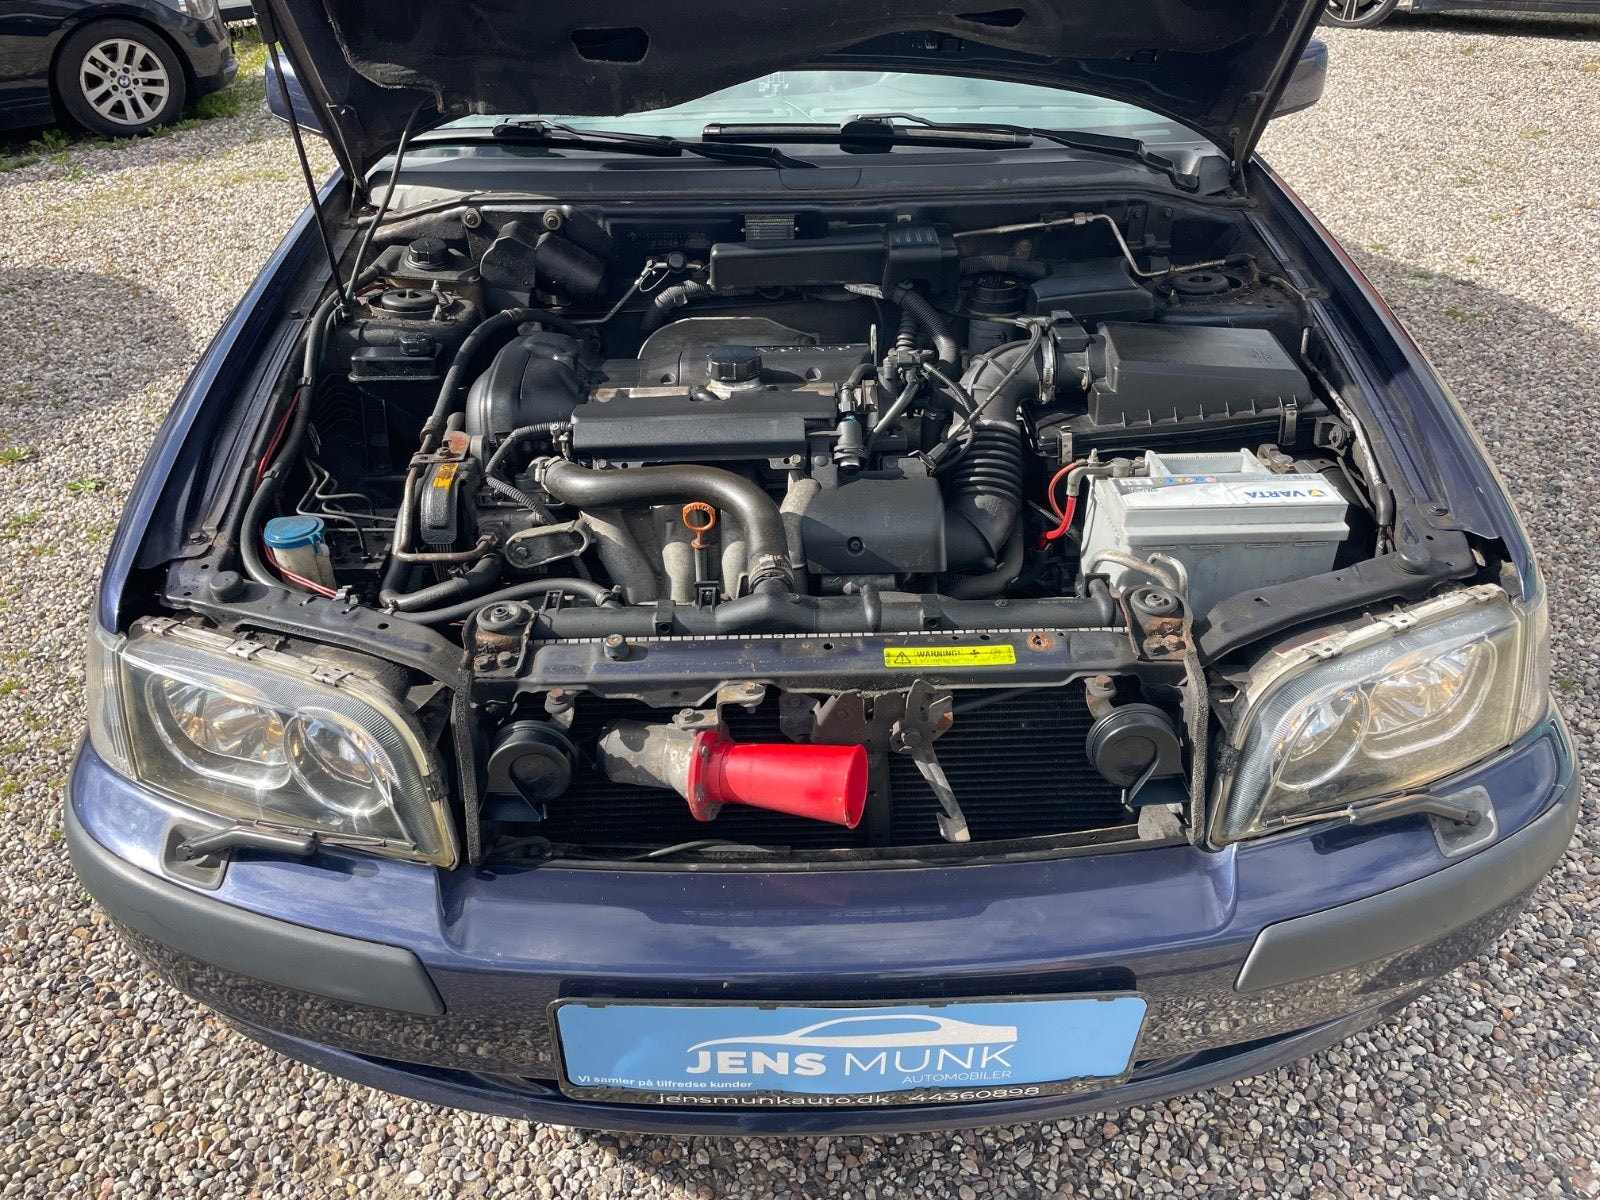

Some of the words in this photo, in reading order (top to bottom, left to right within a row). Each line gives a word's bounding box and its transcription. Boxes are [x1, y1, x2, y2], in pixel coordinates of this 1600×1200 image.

[1243, 490, 1306, 498] VARTA
[916, 649, 960, 658] WARNING!
[686, 1050, 827, 1076] JENS
[844, 1044, 1015, 1076] MUNK
[577, 1075, 591, 1083] Vi
[593, 1076, 636, 1086] samler
[638, 1078, 654, 1088] på
[656, 1079, 707, 1089] tilfredse
[710, 1081, 753, 1089] kunder
[902, 1070, 1012, 1085] AUTOMOBILER
[656, 1093, 890, 1105] jensmunkauto.dk
[910, 1086, 1040, 1102] 44360898
